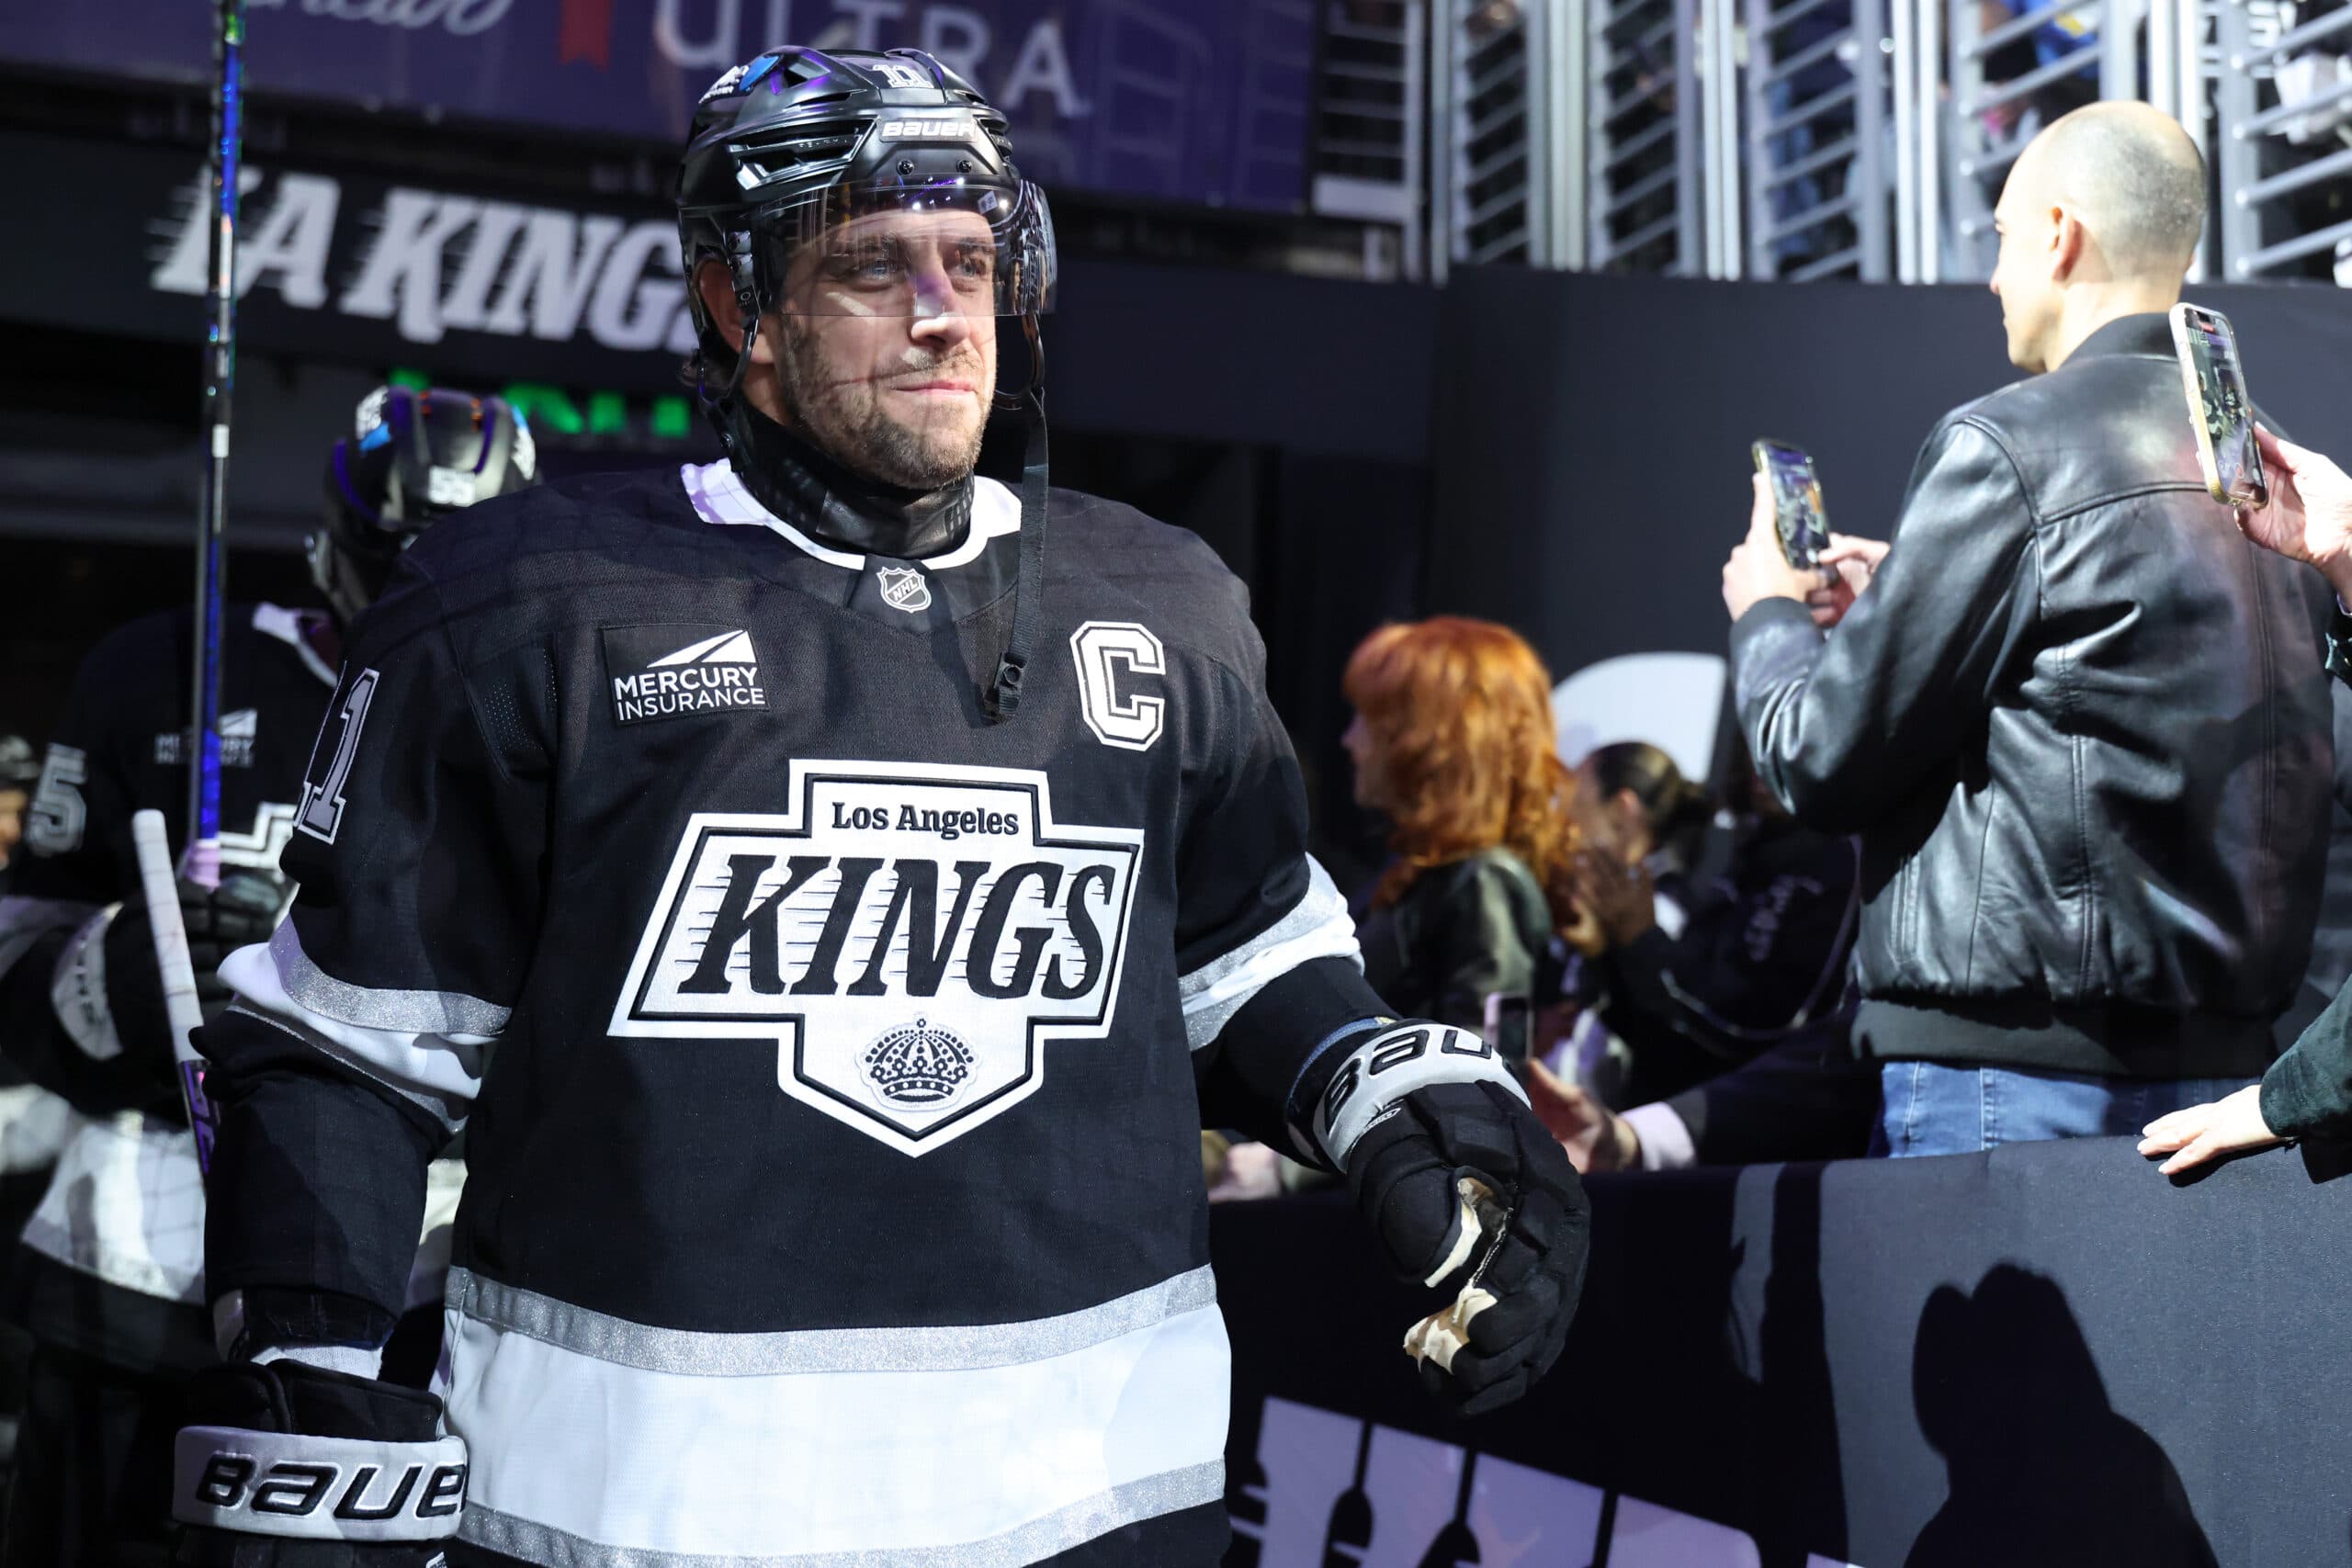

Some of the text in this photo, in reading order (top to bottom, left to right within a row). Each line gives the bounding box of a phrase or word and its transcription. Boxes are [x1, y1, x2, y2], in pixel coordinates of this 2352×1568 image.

[872, 64, 935, 88] 11
[881, 121, 976, 137] BAUER
[338, 187, 701, 356] KING
[892, 579, 918, 602] NHL
[614, 666, 758, 700] MERCURY
[617, 688, 766, 721] INSURANCE
[1069, 620, 1166, 752] C
[293, 660, 379, 845] 1
[831, 801, 1020, 840] Los Angeles
[675, 854, 1116, 1000] KINGS
[1324, 1028, 1520, 1136] BAU
[195, 1453, 469, 1520] BAUE
